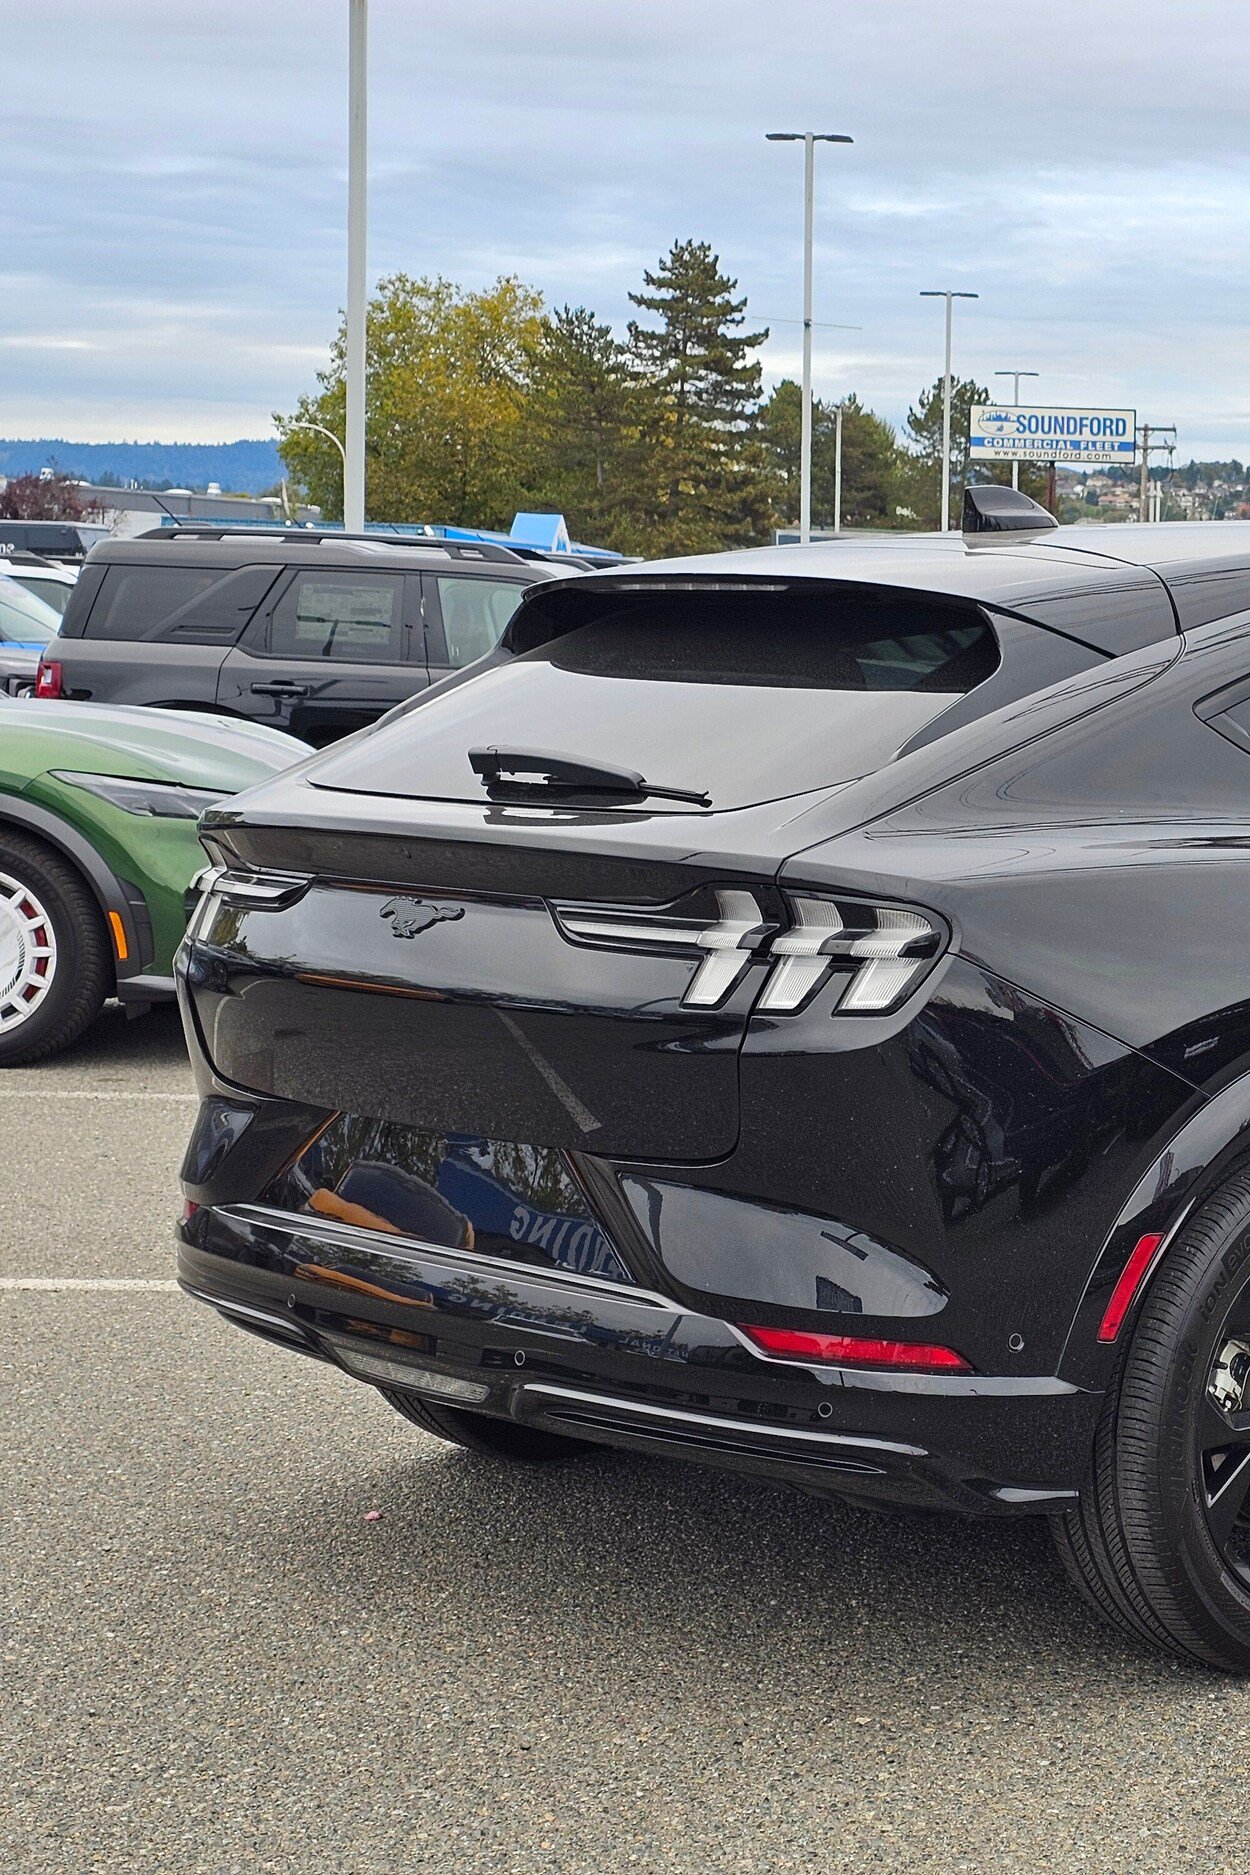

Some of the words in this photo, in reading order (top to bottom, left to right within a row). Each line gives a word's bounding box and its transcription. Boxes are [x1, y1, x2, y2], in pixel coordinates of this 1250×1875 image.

[1016, 414, 1127, 437] SOUNDFORD
[984, 438, 1073, 450] COMMERCIAL
[1080, 441, 1120, 451] FLEET
[994, 449, 1112, 460] www.soundford.com
